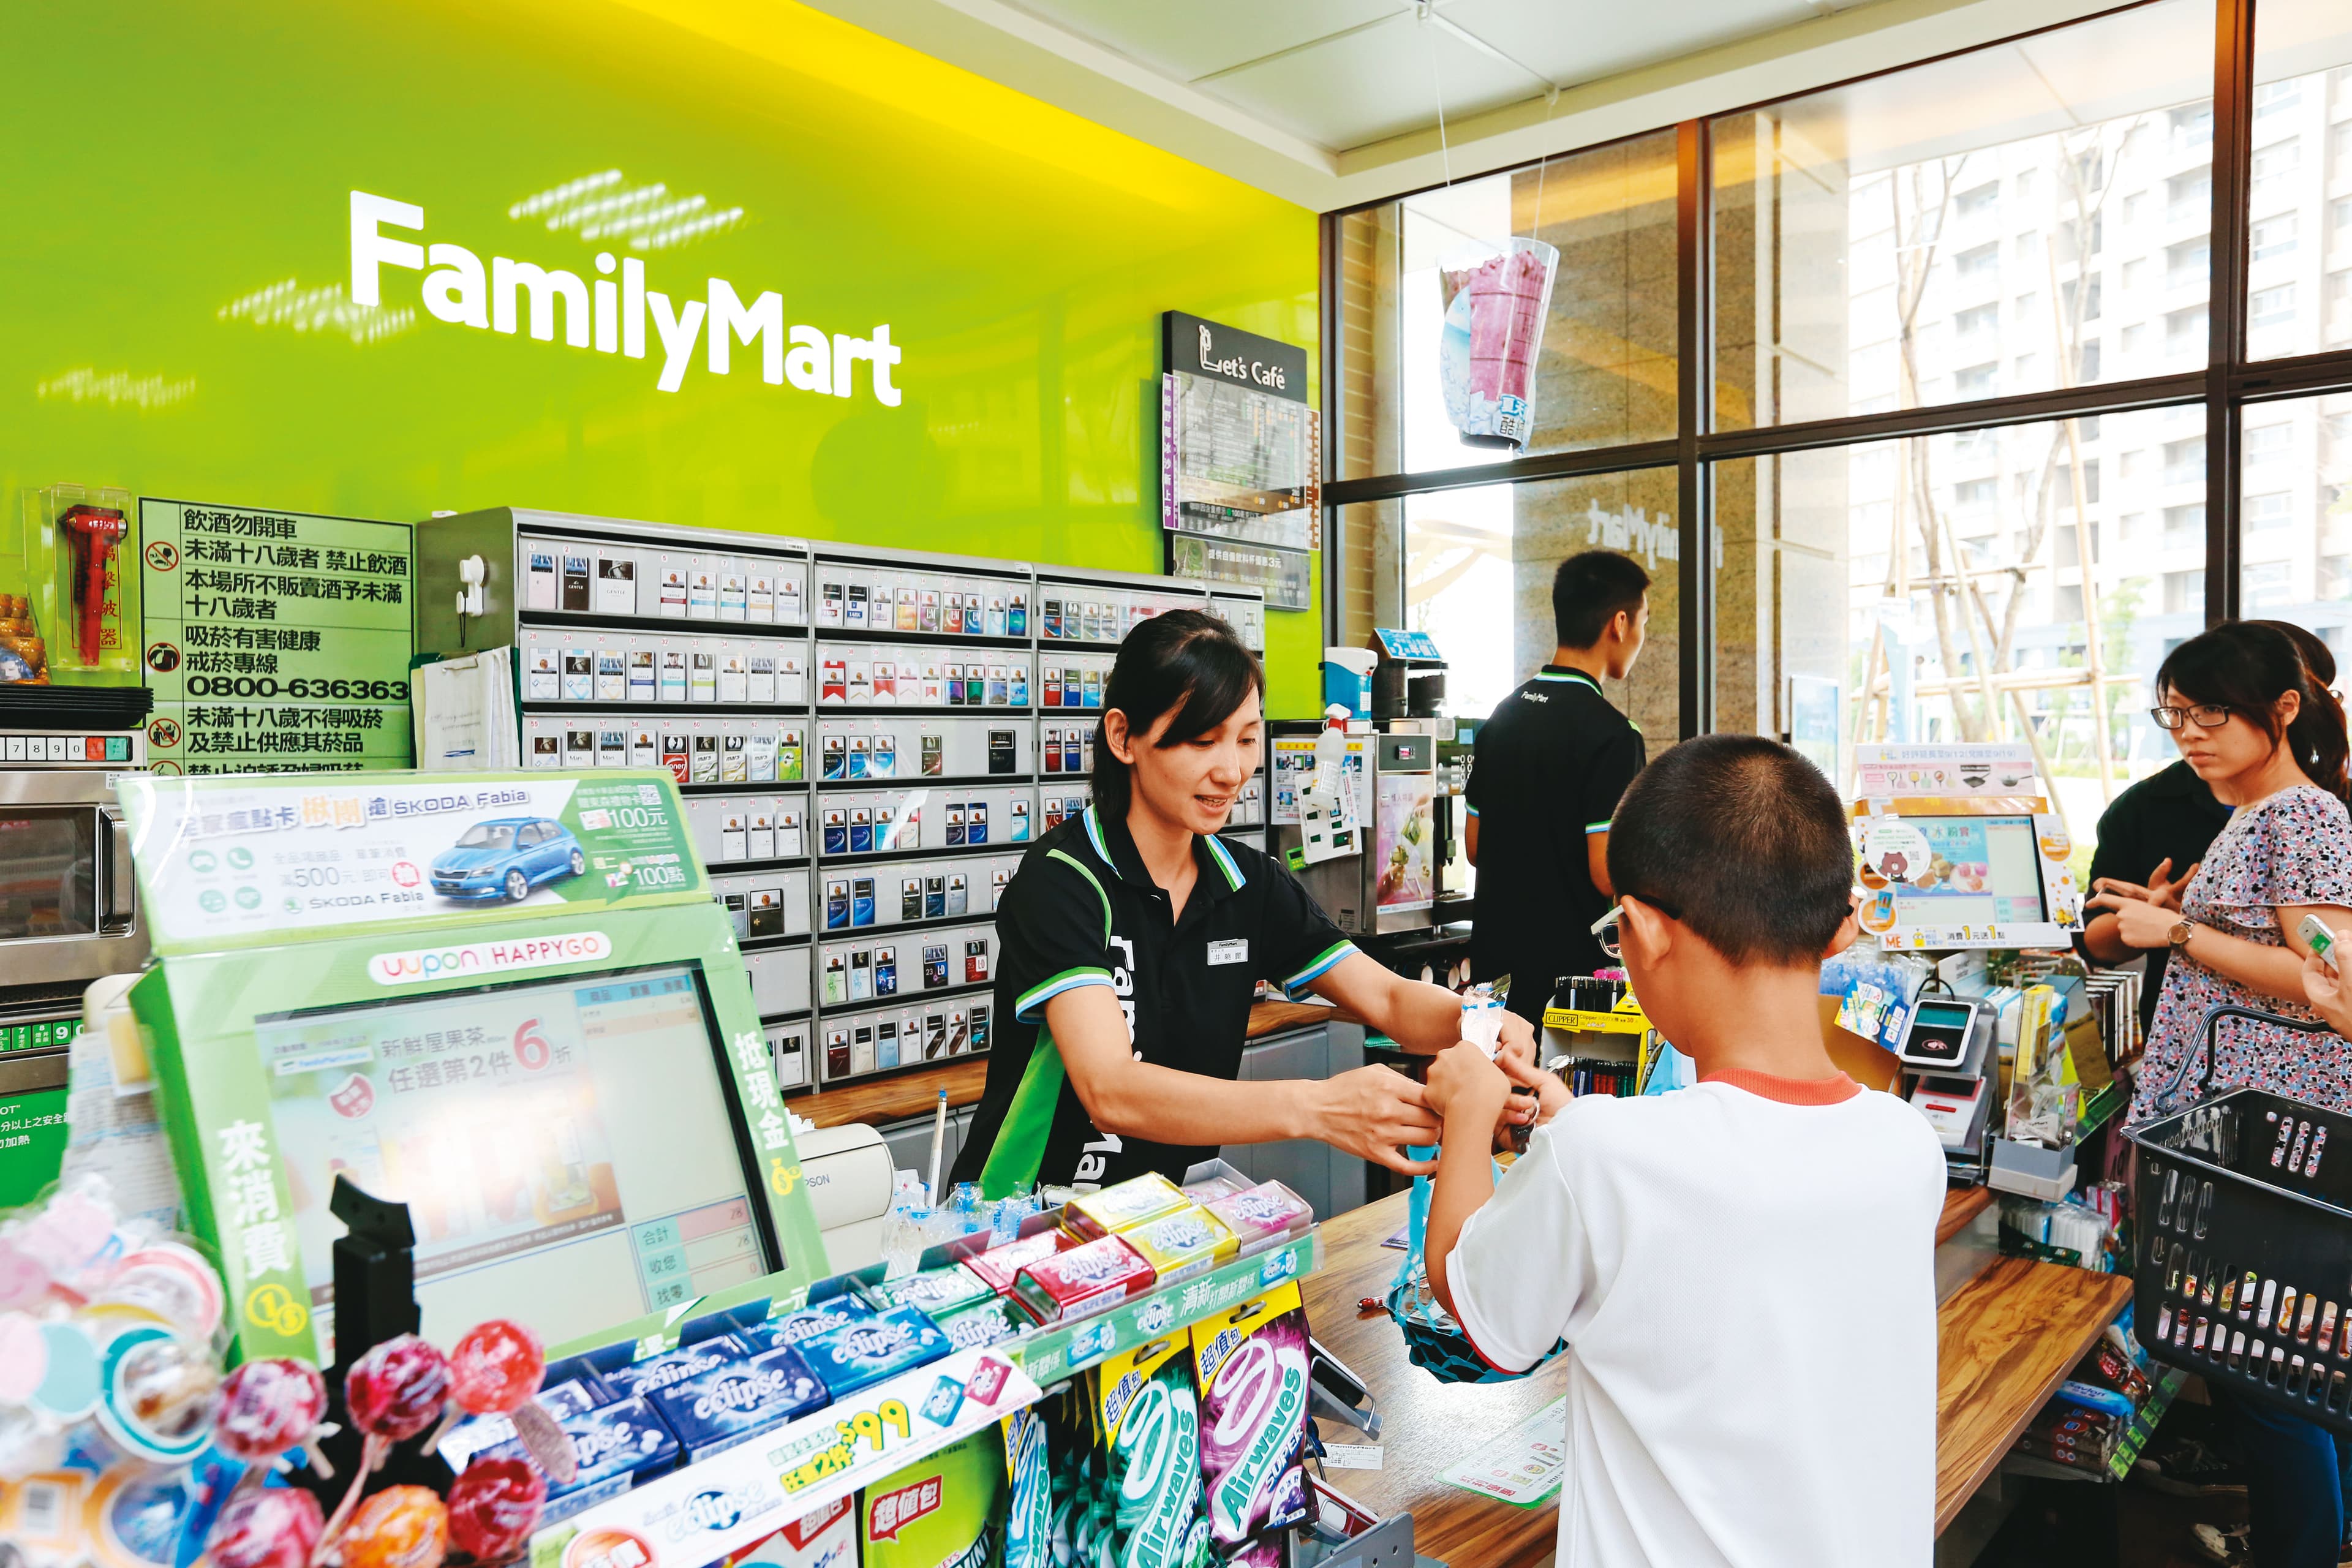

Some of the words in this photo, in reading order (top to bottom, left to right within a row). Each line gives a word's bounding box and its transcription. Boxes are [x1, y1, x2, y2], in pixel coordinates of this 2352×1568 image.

[350, 190, 902, 407] FamilyMart
[1199, 325, 1246, 379] Let's
[1251, 361, 1285, 390] Café
[184, 509, 297, 539] 飲酒勿開車
[185, 538, 320, 570] 未滿十八歲者
[326, 551, 407, 576] 禁止飲酒
[185, 570, 402, 604] 本場所不販賣酒予未滿
[185, 594, 277, 620] 十八歲者
[186, 626, 320, 652] 吸菸有害健康
[186, 652, 278, 674] 戒菸專線
[186, 676, 409, 700] 0800-636363
[1521, 690, 1549, 703] FamilyMart
[187, 706, 383, 729] 未滿十八歲不得吸菸
[189, 733, 364, 754] 及禁止供應其菸品
[477, 790, 529, 807] Fabia
[609, 808, 668, 828] 100元
[633, 865, 686, 886] 100點
[381, 891, 424, 905] Fabia
[1886, 935, 1902, 948] ME
[56, 1027, 68, 1039] 9
[1548, 1015, 1576, 1024] CLIPPER
[381, 1027, 485, 1059] 新鮮屋果茶
[388, 1051, 512, 1094] 任選第2件
[513, 1018, 551, 1071] 6
[555, 1045, 572, 1064] 折
[734, 1031, 790, 1150] 抵現金
[805, 1174, 830, 1187] SON
[218, 1119, 290, 1278] 來消費
[1233, 1194, 1284, 1221] eclipse
[642, 1227, 669, 1245] 合計
[729, 1207, 743, 1221] 28
[736, 1235, 750, 1248] 28
[1152, 1219, 1208, 1251] eclipse
[1059, 1248, 1123, 1284] eclipse
[656, 1283, 684, 1303] 找零
[750, 1262, 756, 1274] 0
[1137, 1304, 1174, 1330] eclipse
[832, 1320, 914, 1365] eclipse
[950, 1315, 1011, 1354] clipse
[1200, 1326, 1243, 1382] 超值包
[694, 1368, 788, 1420] eclipse
[1105, 1369, 1142, 1431] 超值包
[835, 1399, 911, 1450] $99
[1220, 1366, 1301, 1532] Airwaves
[1265, 1424, 1304, 1492] SUPER
[1136, 1410, 1195, 1568] Airwaves
[873, 1480, 939, 1535] 超值包
